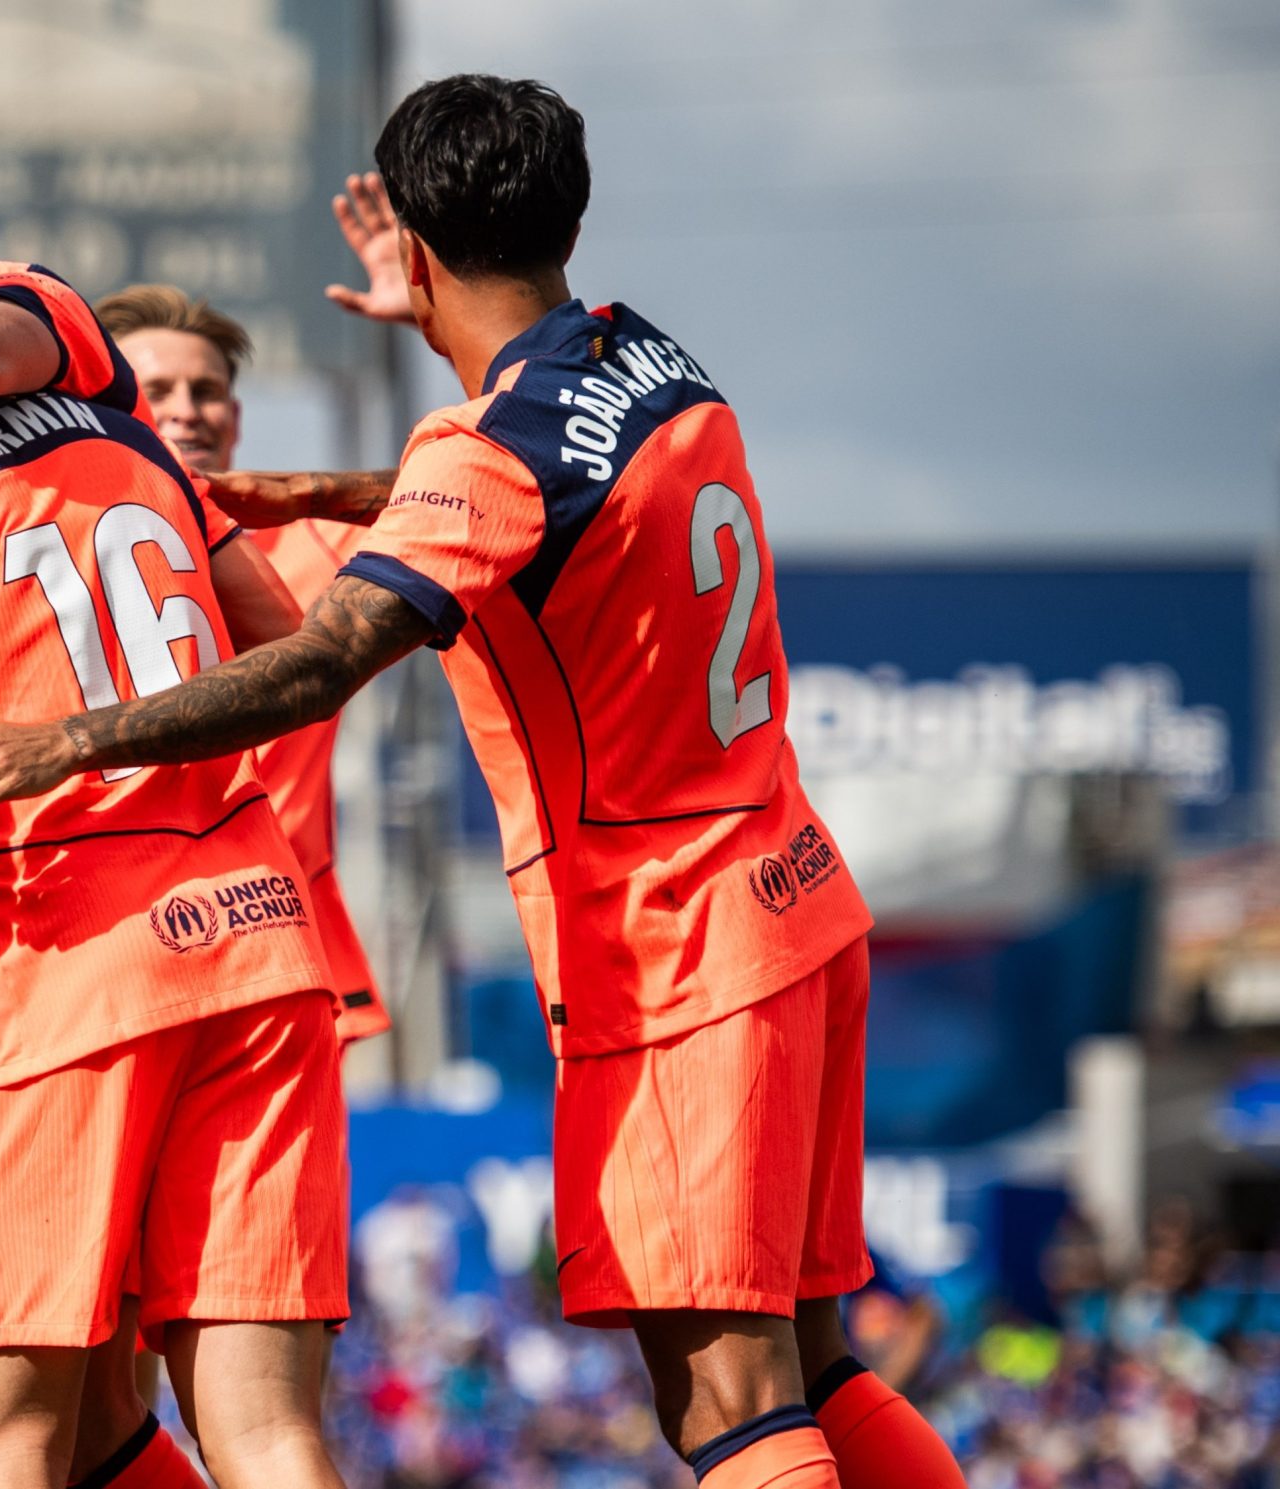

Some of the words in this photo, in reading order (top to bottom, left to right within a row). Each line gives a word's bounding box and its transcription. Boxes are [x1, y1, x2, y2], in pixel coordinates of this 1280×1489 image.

[558, 377, 632, 482] JOÃO
[600, 338, 714, 399] ANCEL
[470, 505, 486, 520] tv
[690, 482, 773, 751] 2
[3, 502, 221, 784] 16
[794, 842, 836, 888] ACNUR
[214, 876, 300, 908] UNHCR
[227, 897, 307, 929] ACNUR
